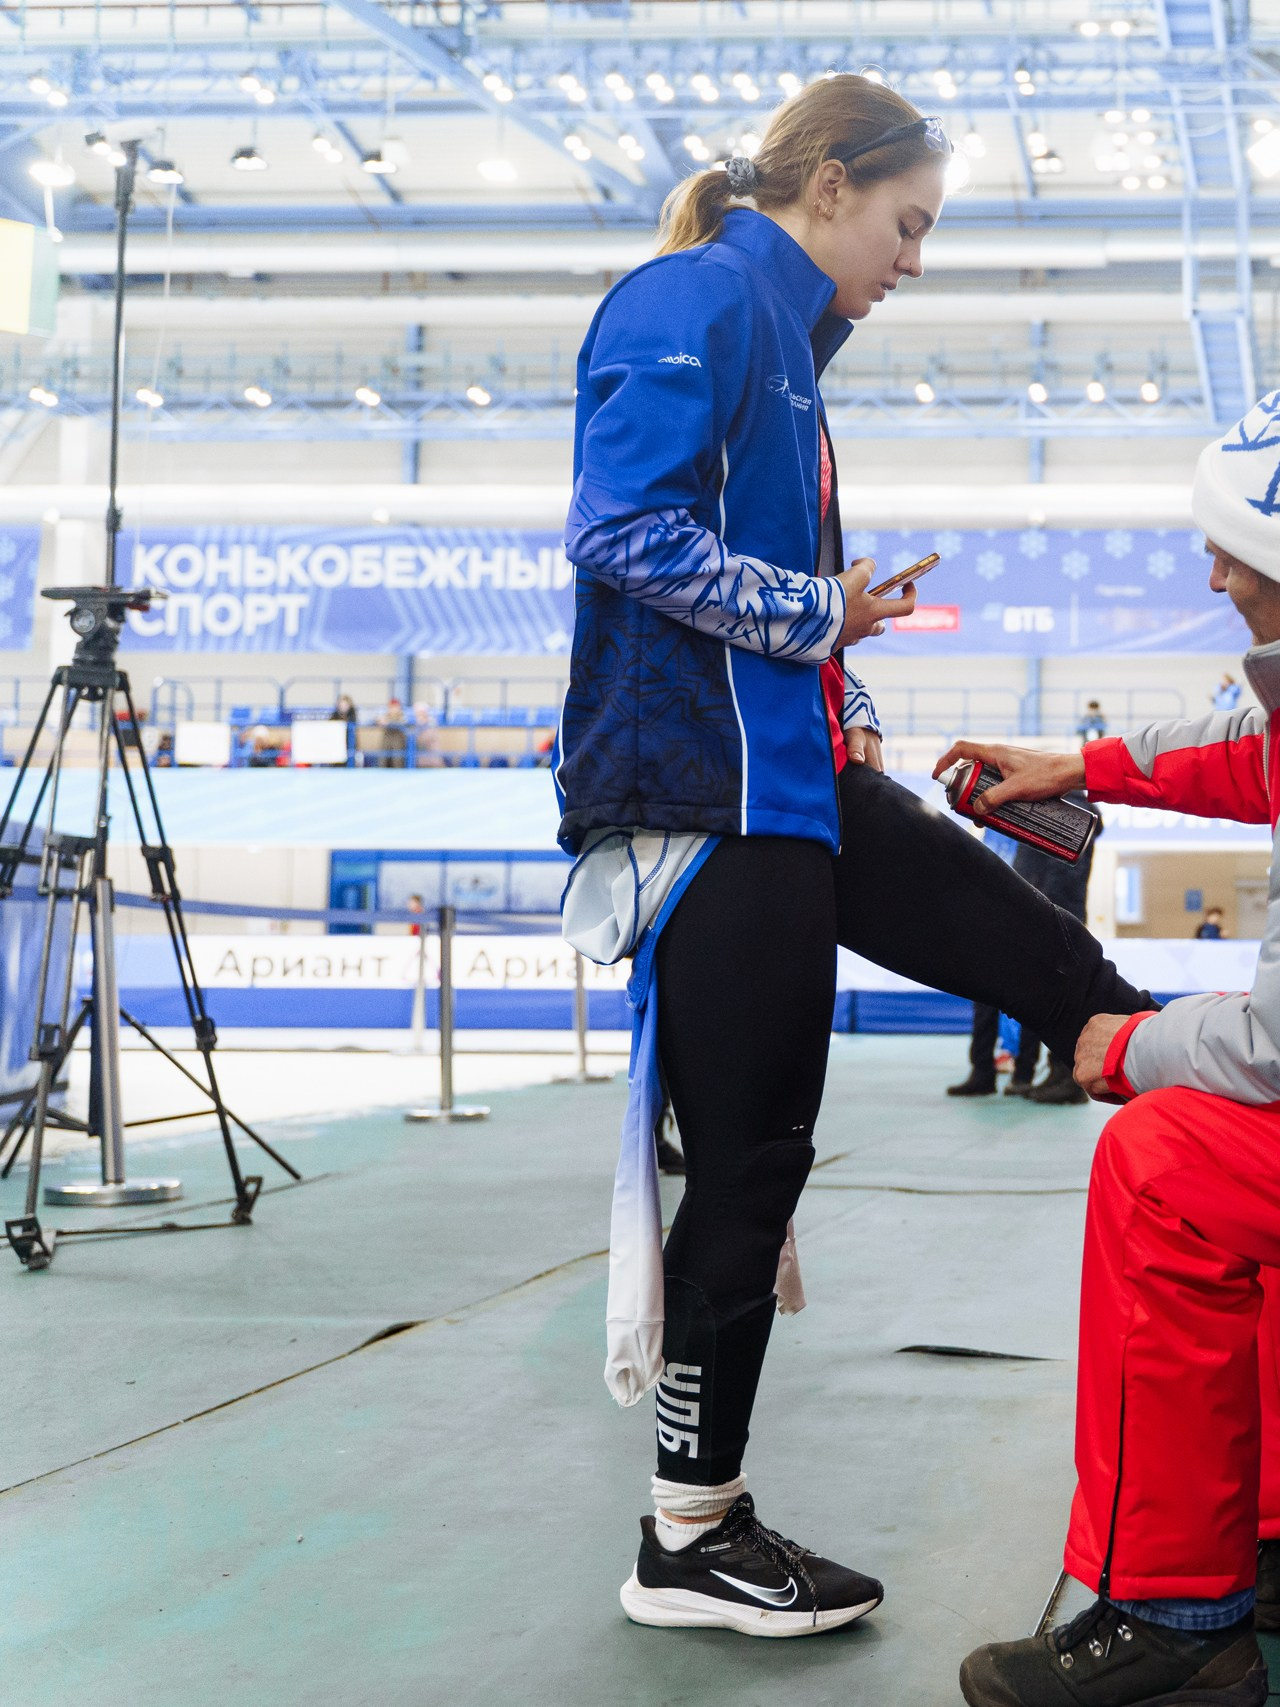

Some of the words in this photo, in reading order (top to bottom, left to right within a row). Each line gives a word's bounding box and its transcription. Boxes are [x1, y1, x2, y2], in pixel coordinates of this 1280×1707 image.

[128, 592, 308, 637] СПОРТ
[1003, 606, 1055, 633] ВТБ
[214, 949, 390, 988] Ариант
